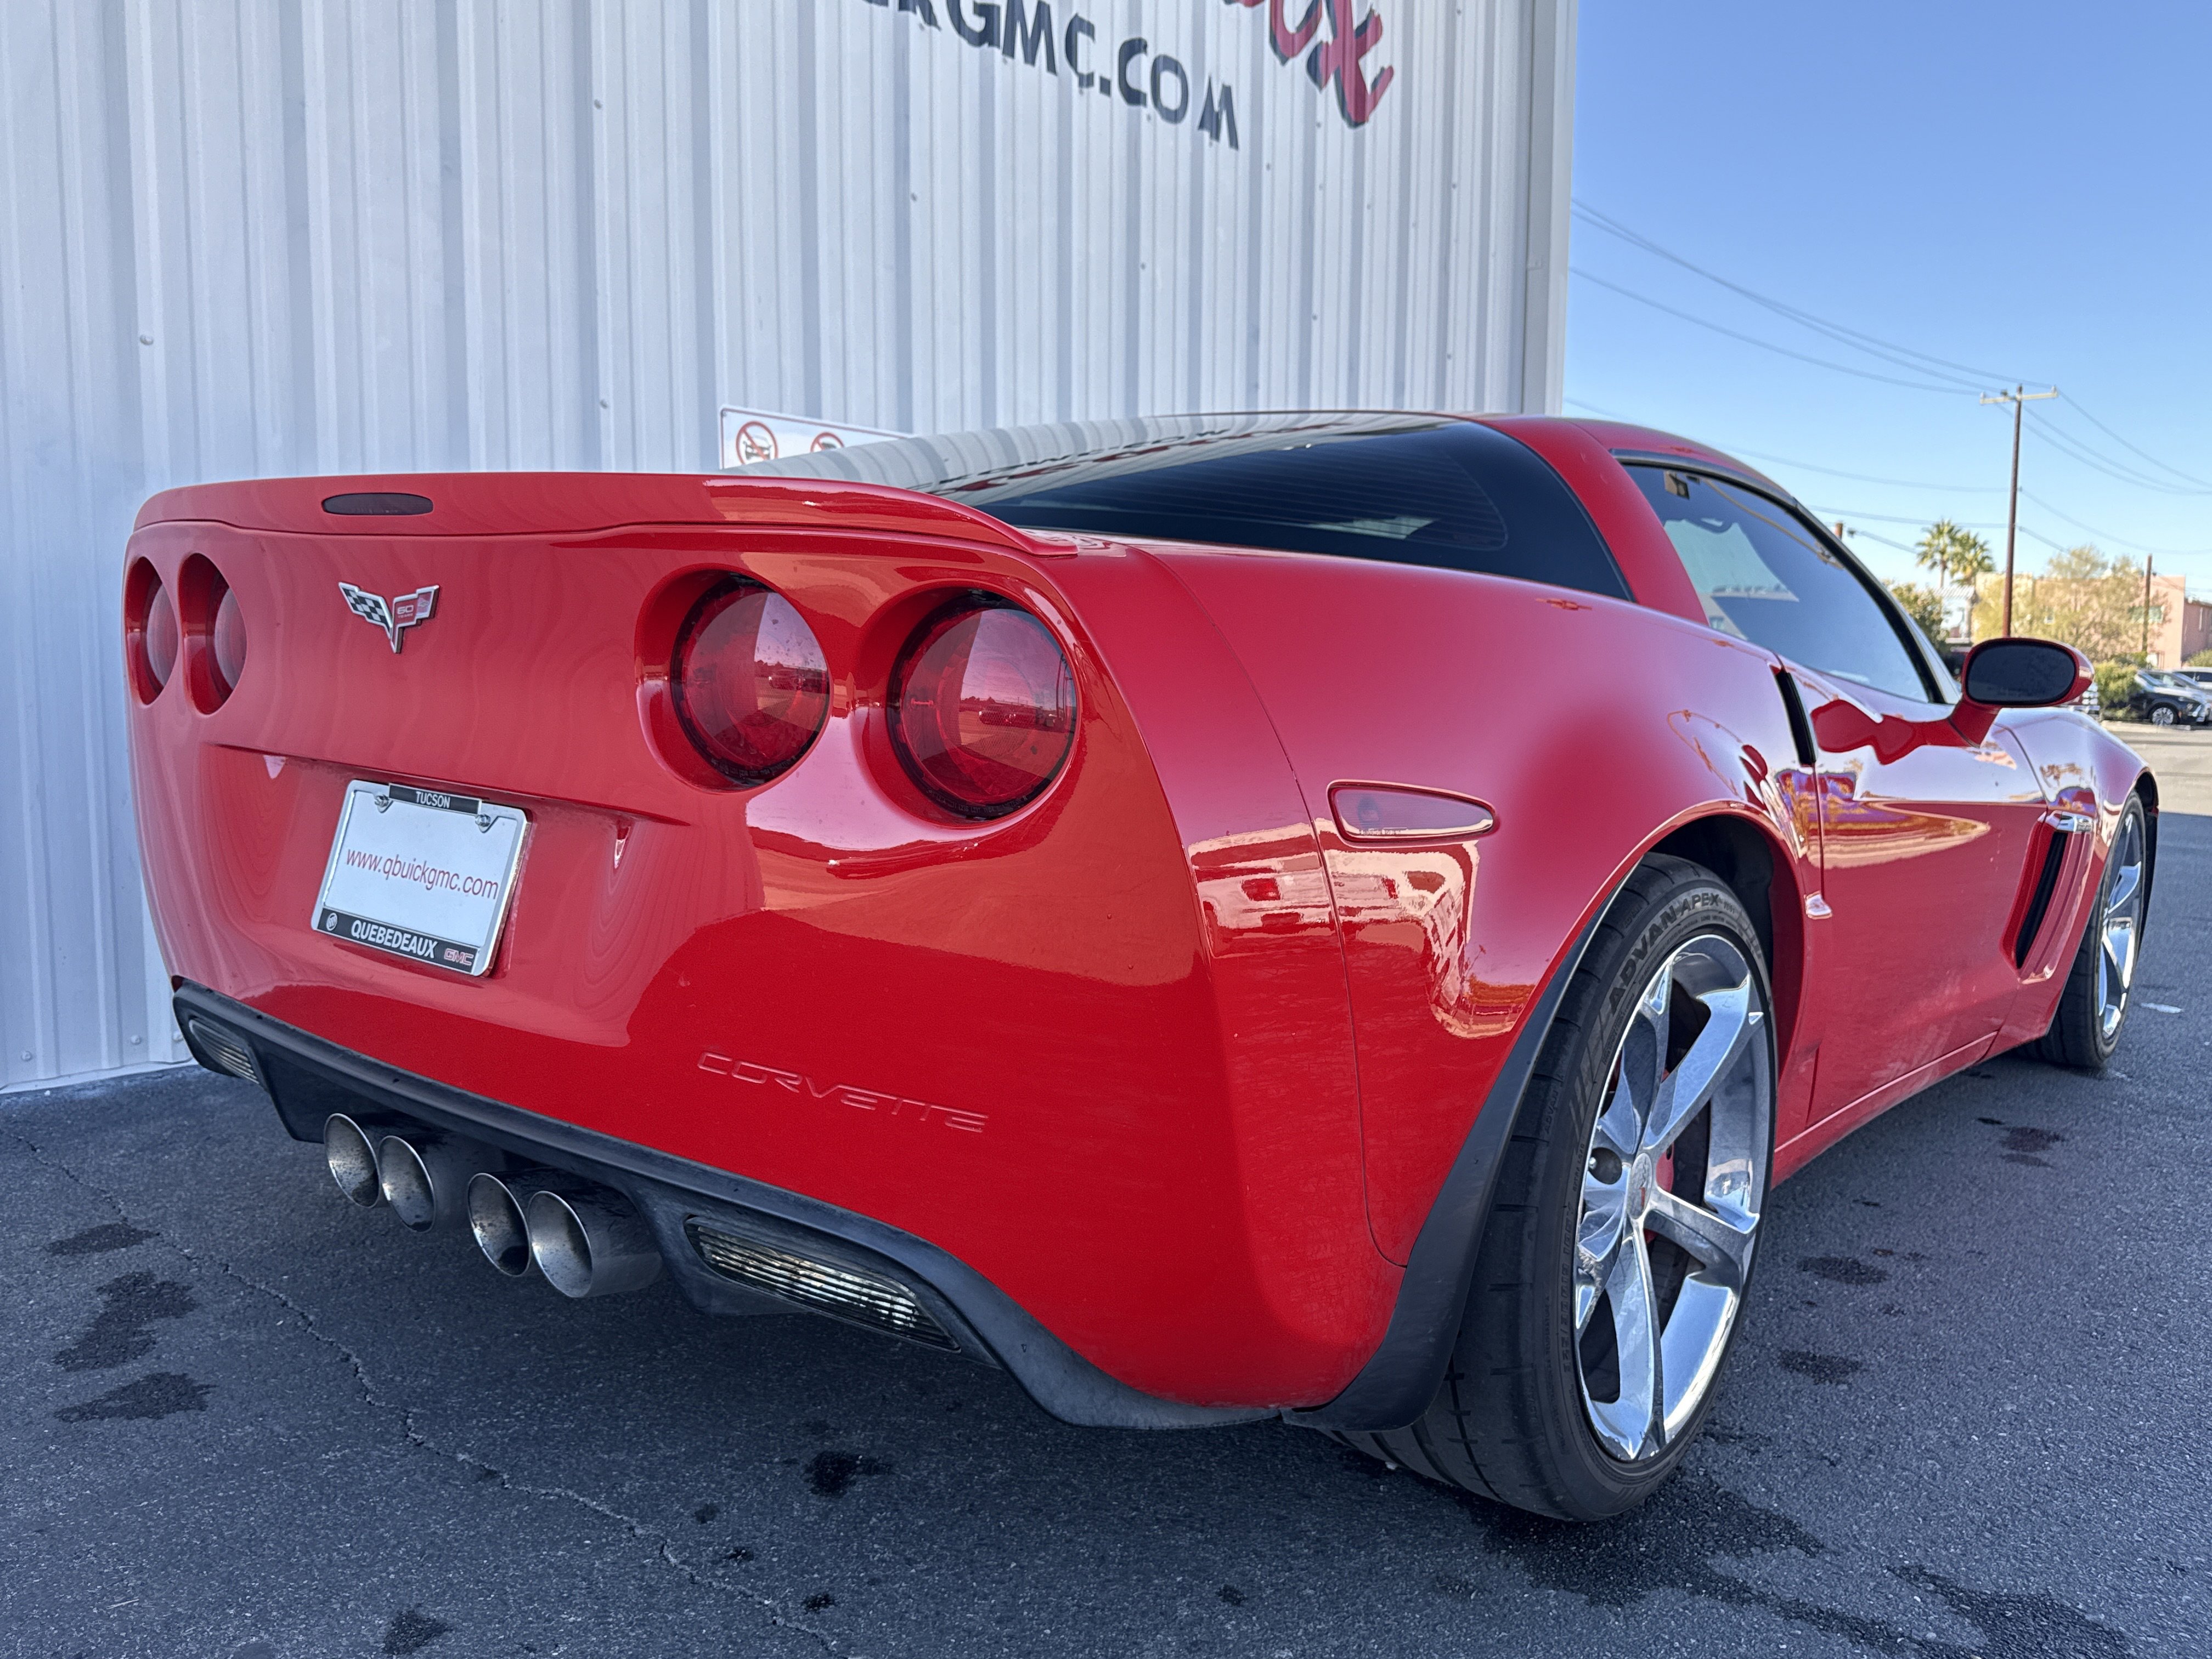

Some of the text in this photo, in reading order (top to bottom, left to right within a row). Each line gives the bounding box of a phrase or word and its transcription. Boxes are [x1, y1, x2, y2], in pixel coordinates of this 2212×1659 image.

[863, 0, 1239, 150] GMC.COM
[398, 605, 414, 615] 60
[415, 791, 451, 809] TUCSON
[346, 849, 499, 900] www.qbuickgmc.com
[351, 919, 474, 966] QUEBEDEAUX GMC
[1609, 905, 1678, 1017] ADVAN
[1679, 892, 1719, 916] APEX
[697, 1051, 988, 1132] CORVETTE
